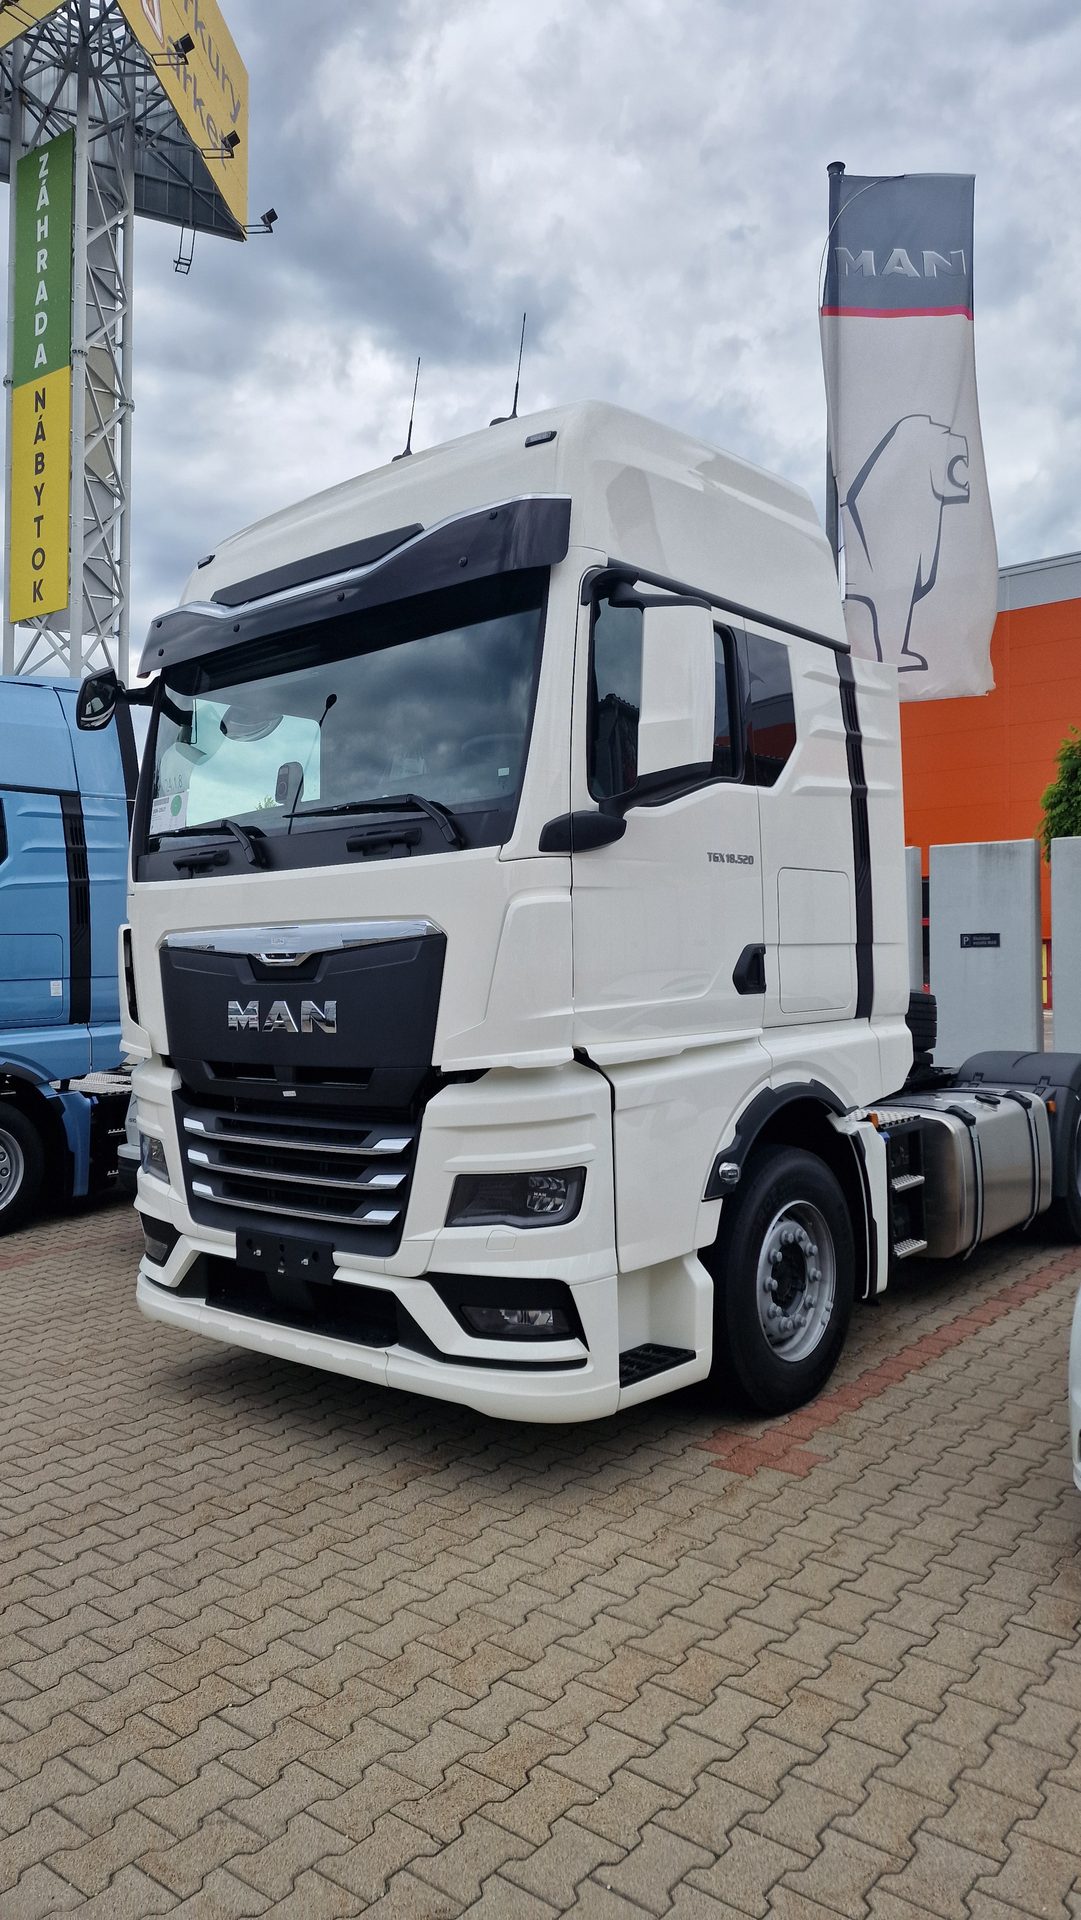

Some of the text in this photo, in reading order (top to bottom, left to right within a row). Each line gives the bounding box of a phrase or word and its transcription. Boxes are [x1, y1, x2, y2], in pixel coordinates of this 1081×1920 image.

[34, 152, 50, 369] ZÁHRADA
[834, 247, 967, 279] MAN
[31, 387, 47, 603] NÁBYTOK
[227, 1000, 337, 1034] MAN
